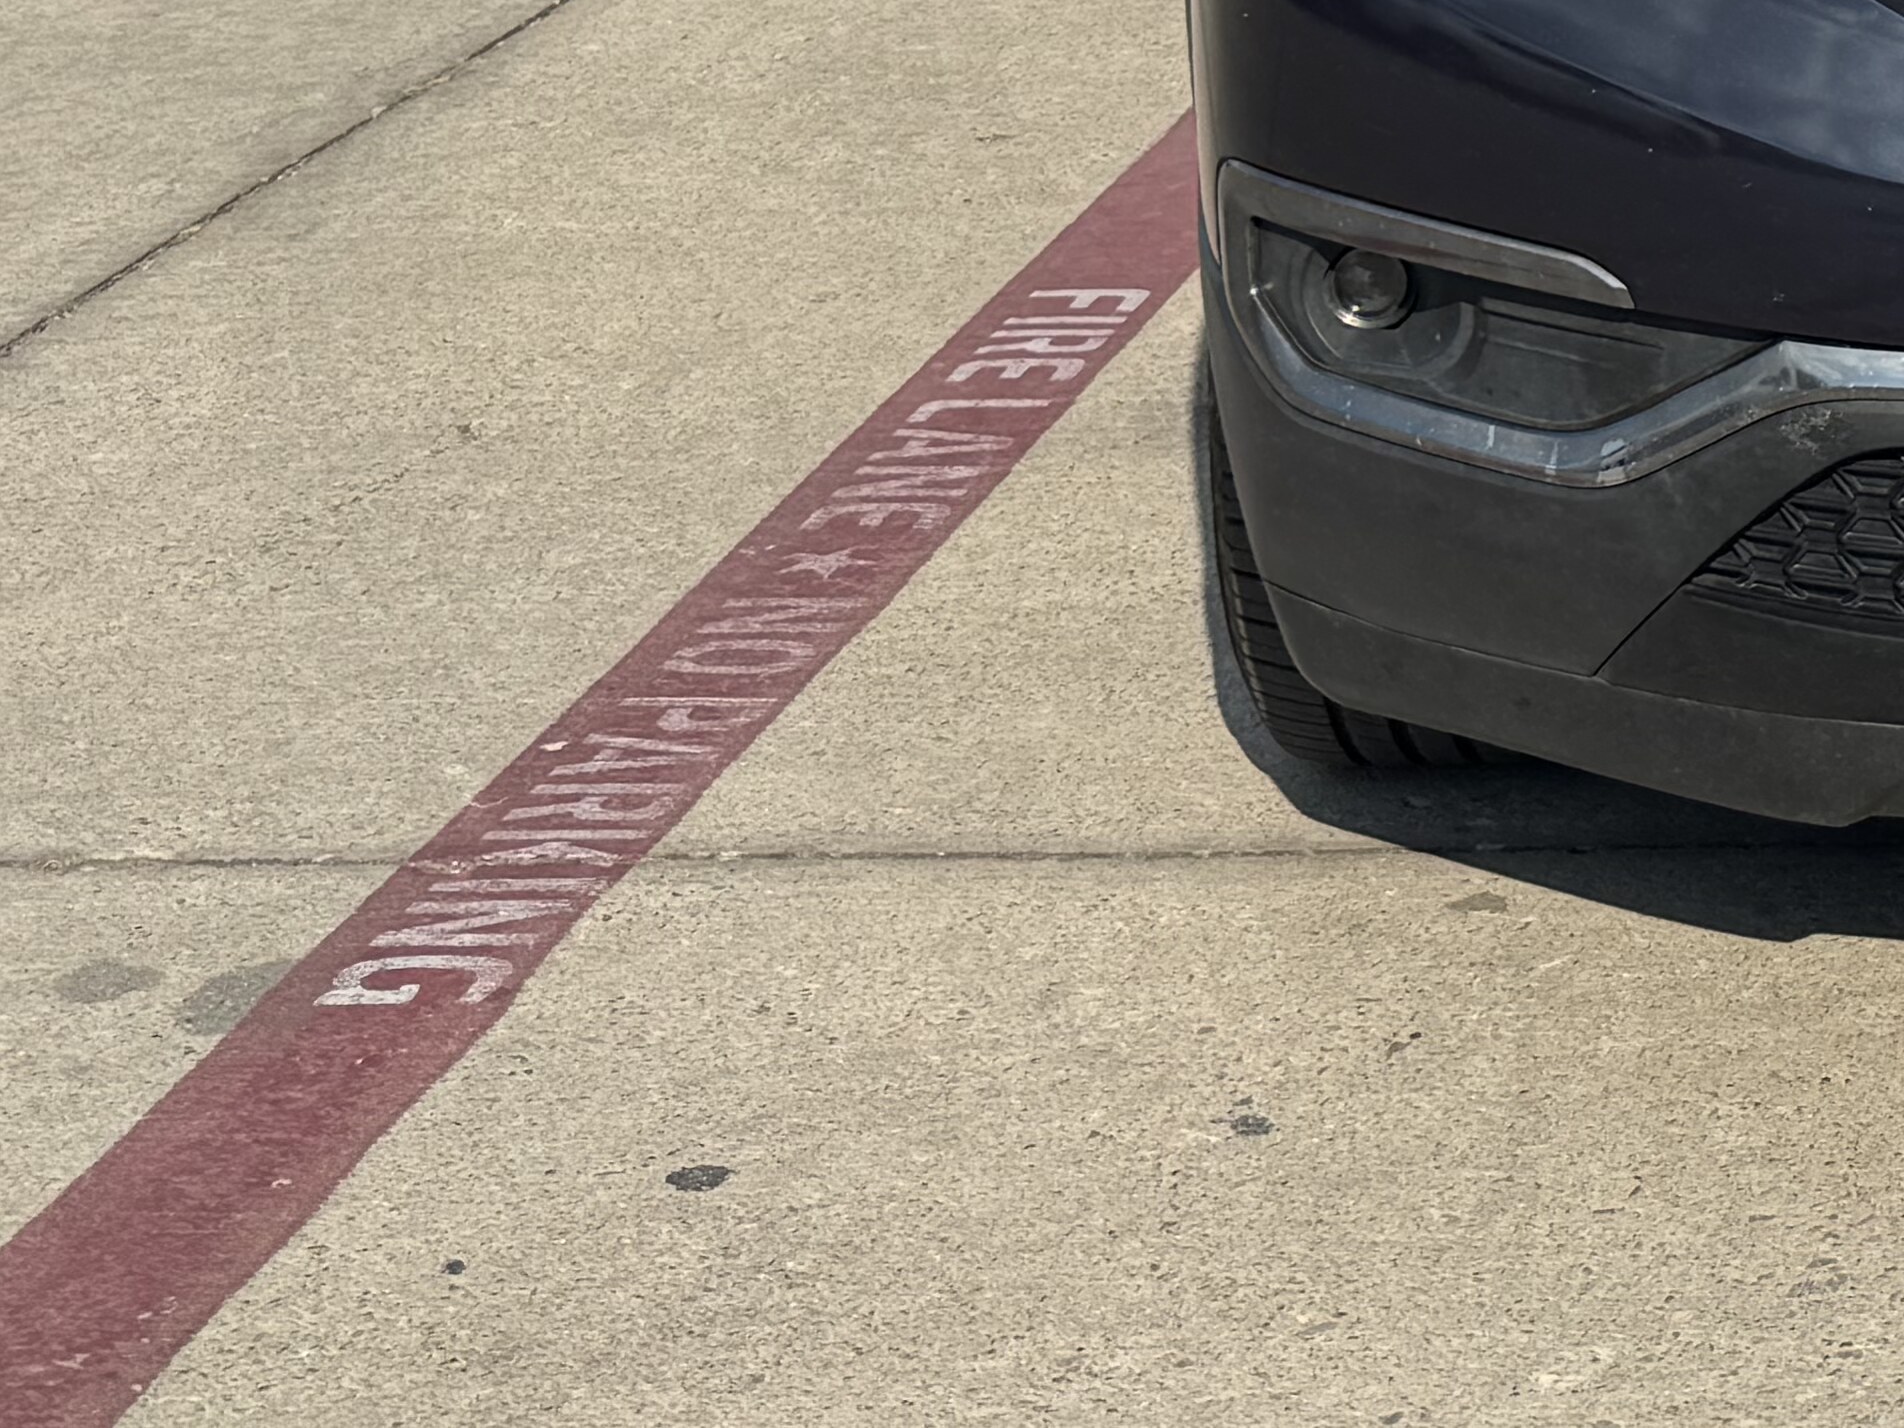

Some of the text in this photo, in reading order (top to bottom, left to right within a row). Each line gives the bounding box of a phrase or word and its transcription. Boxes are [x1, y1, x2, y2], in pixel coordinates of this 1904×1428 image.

[313, 288, 1151, 1006] FIRE LANE NO PARKING
